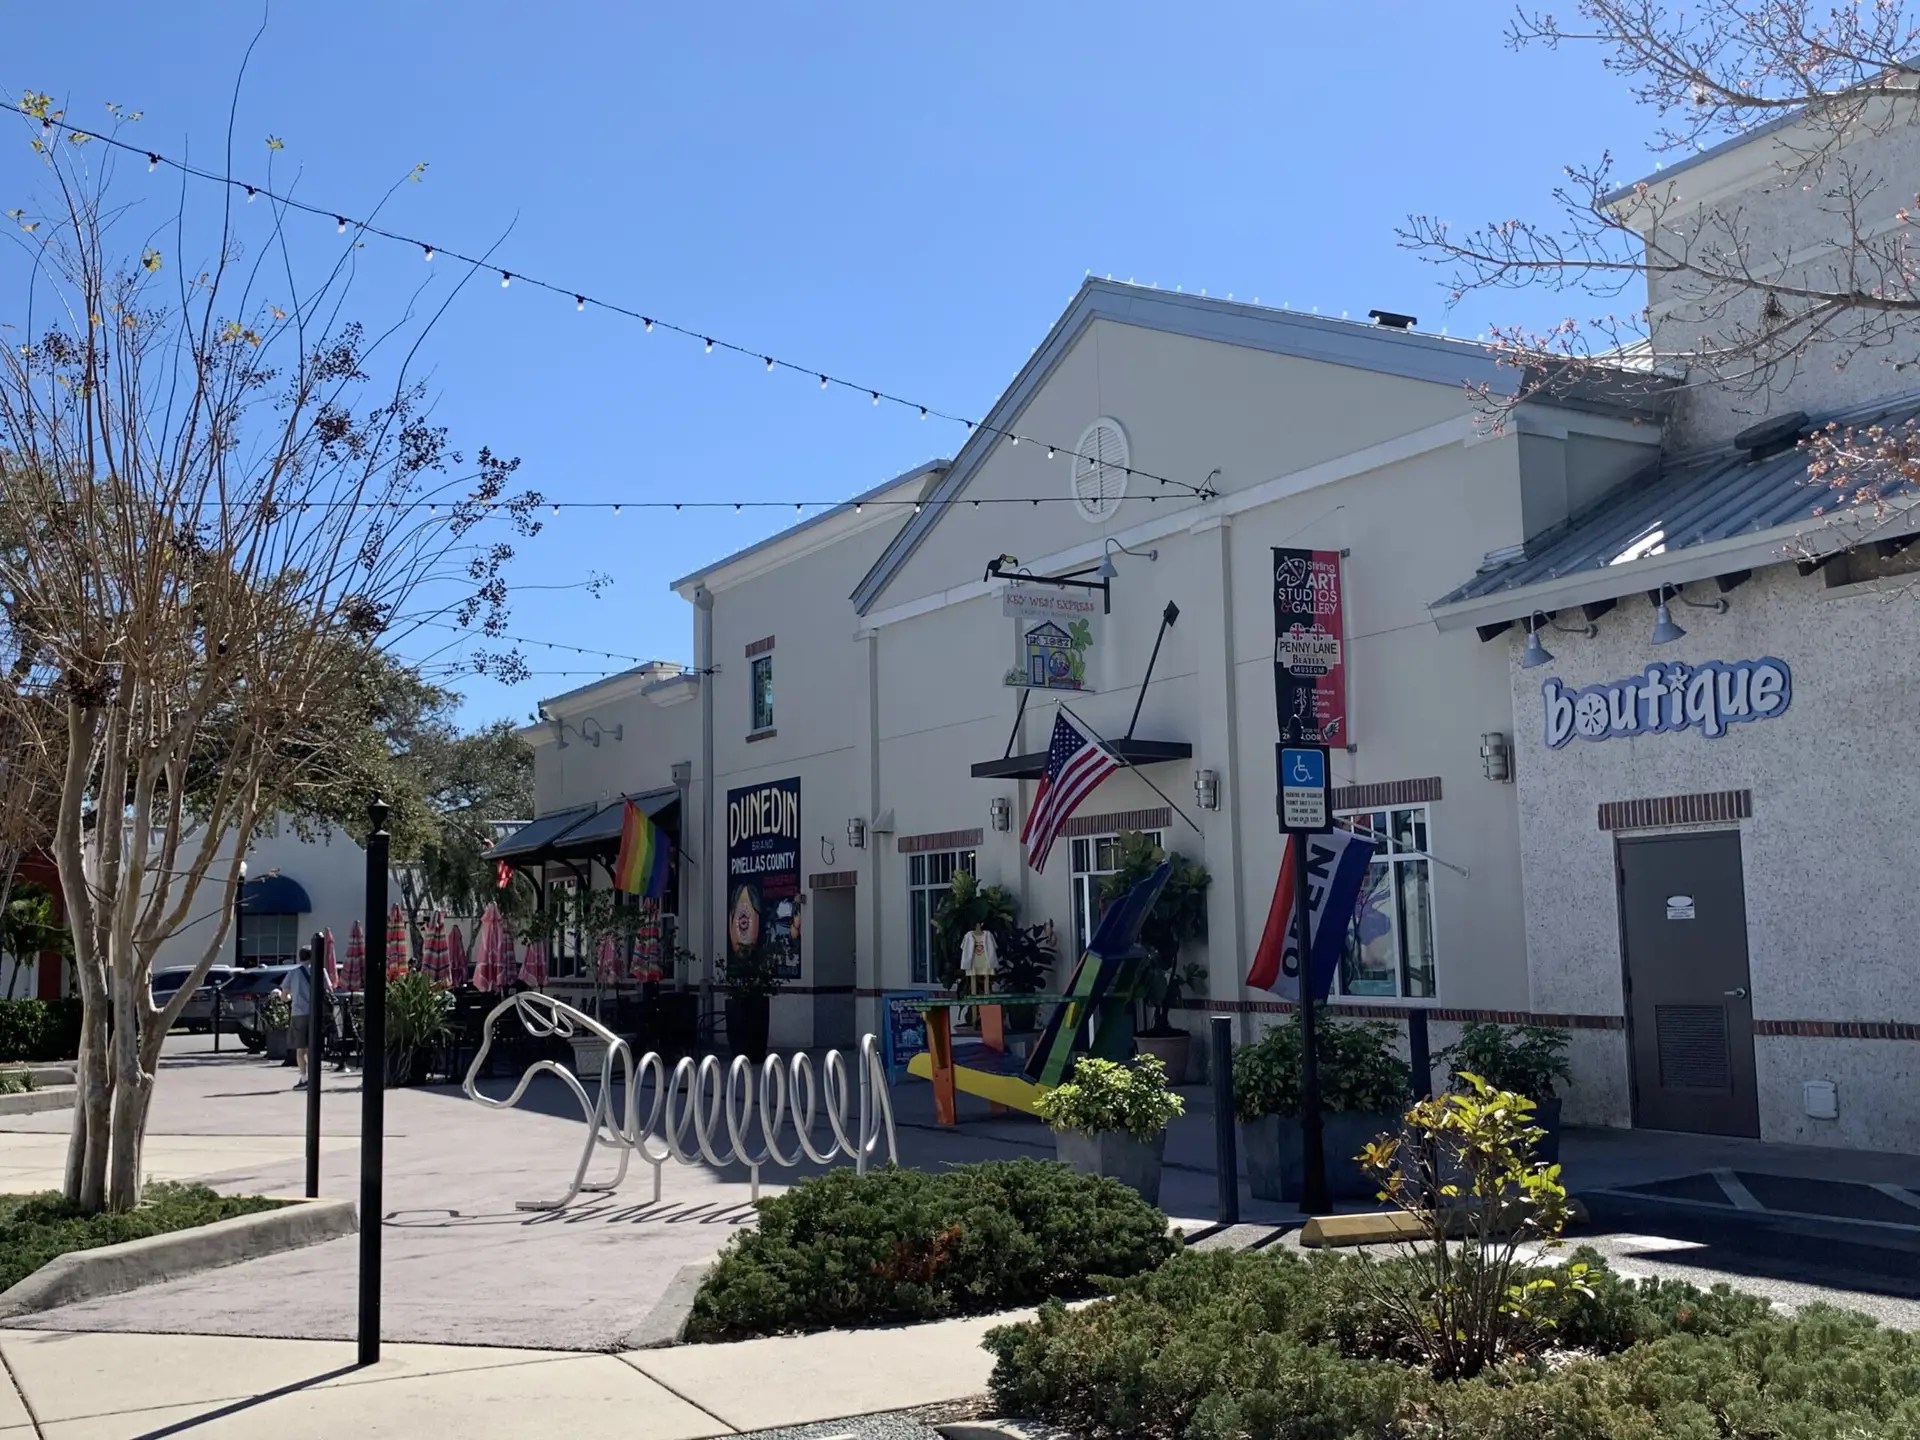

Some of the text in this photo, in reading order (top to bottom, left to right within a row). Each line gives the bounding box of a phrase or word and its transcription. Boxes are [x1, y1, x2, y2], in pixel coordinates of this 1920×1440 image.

[1306, 573, 1336, 589] ART
[1278, 588, 1337, 602] STUDIOS
[1280, 642, 1337, 654] PENNY LANE
[1293, 665, 1325, 674] MUSEUM
[1544, 666, 1783, 746] boutique
[730, 788, 797, 847] DUNEDIN
[731, 851, 796, 875] PINELLAS COUNTY
